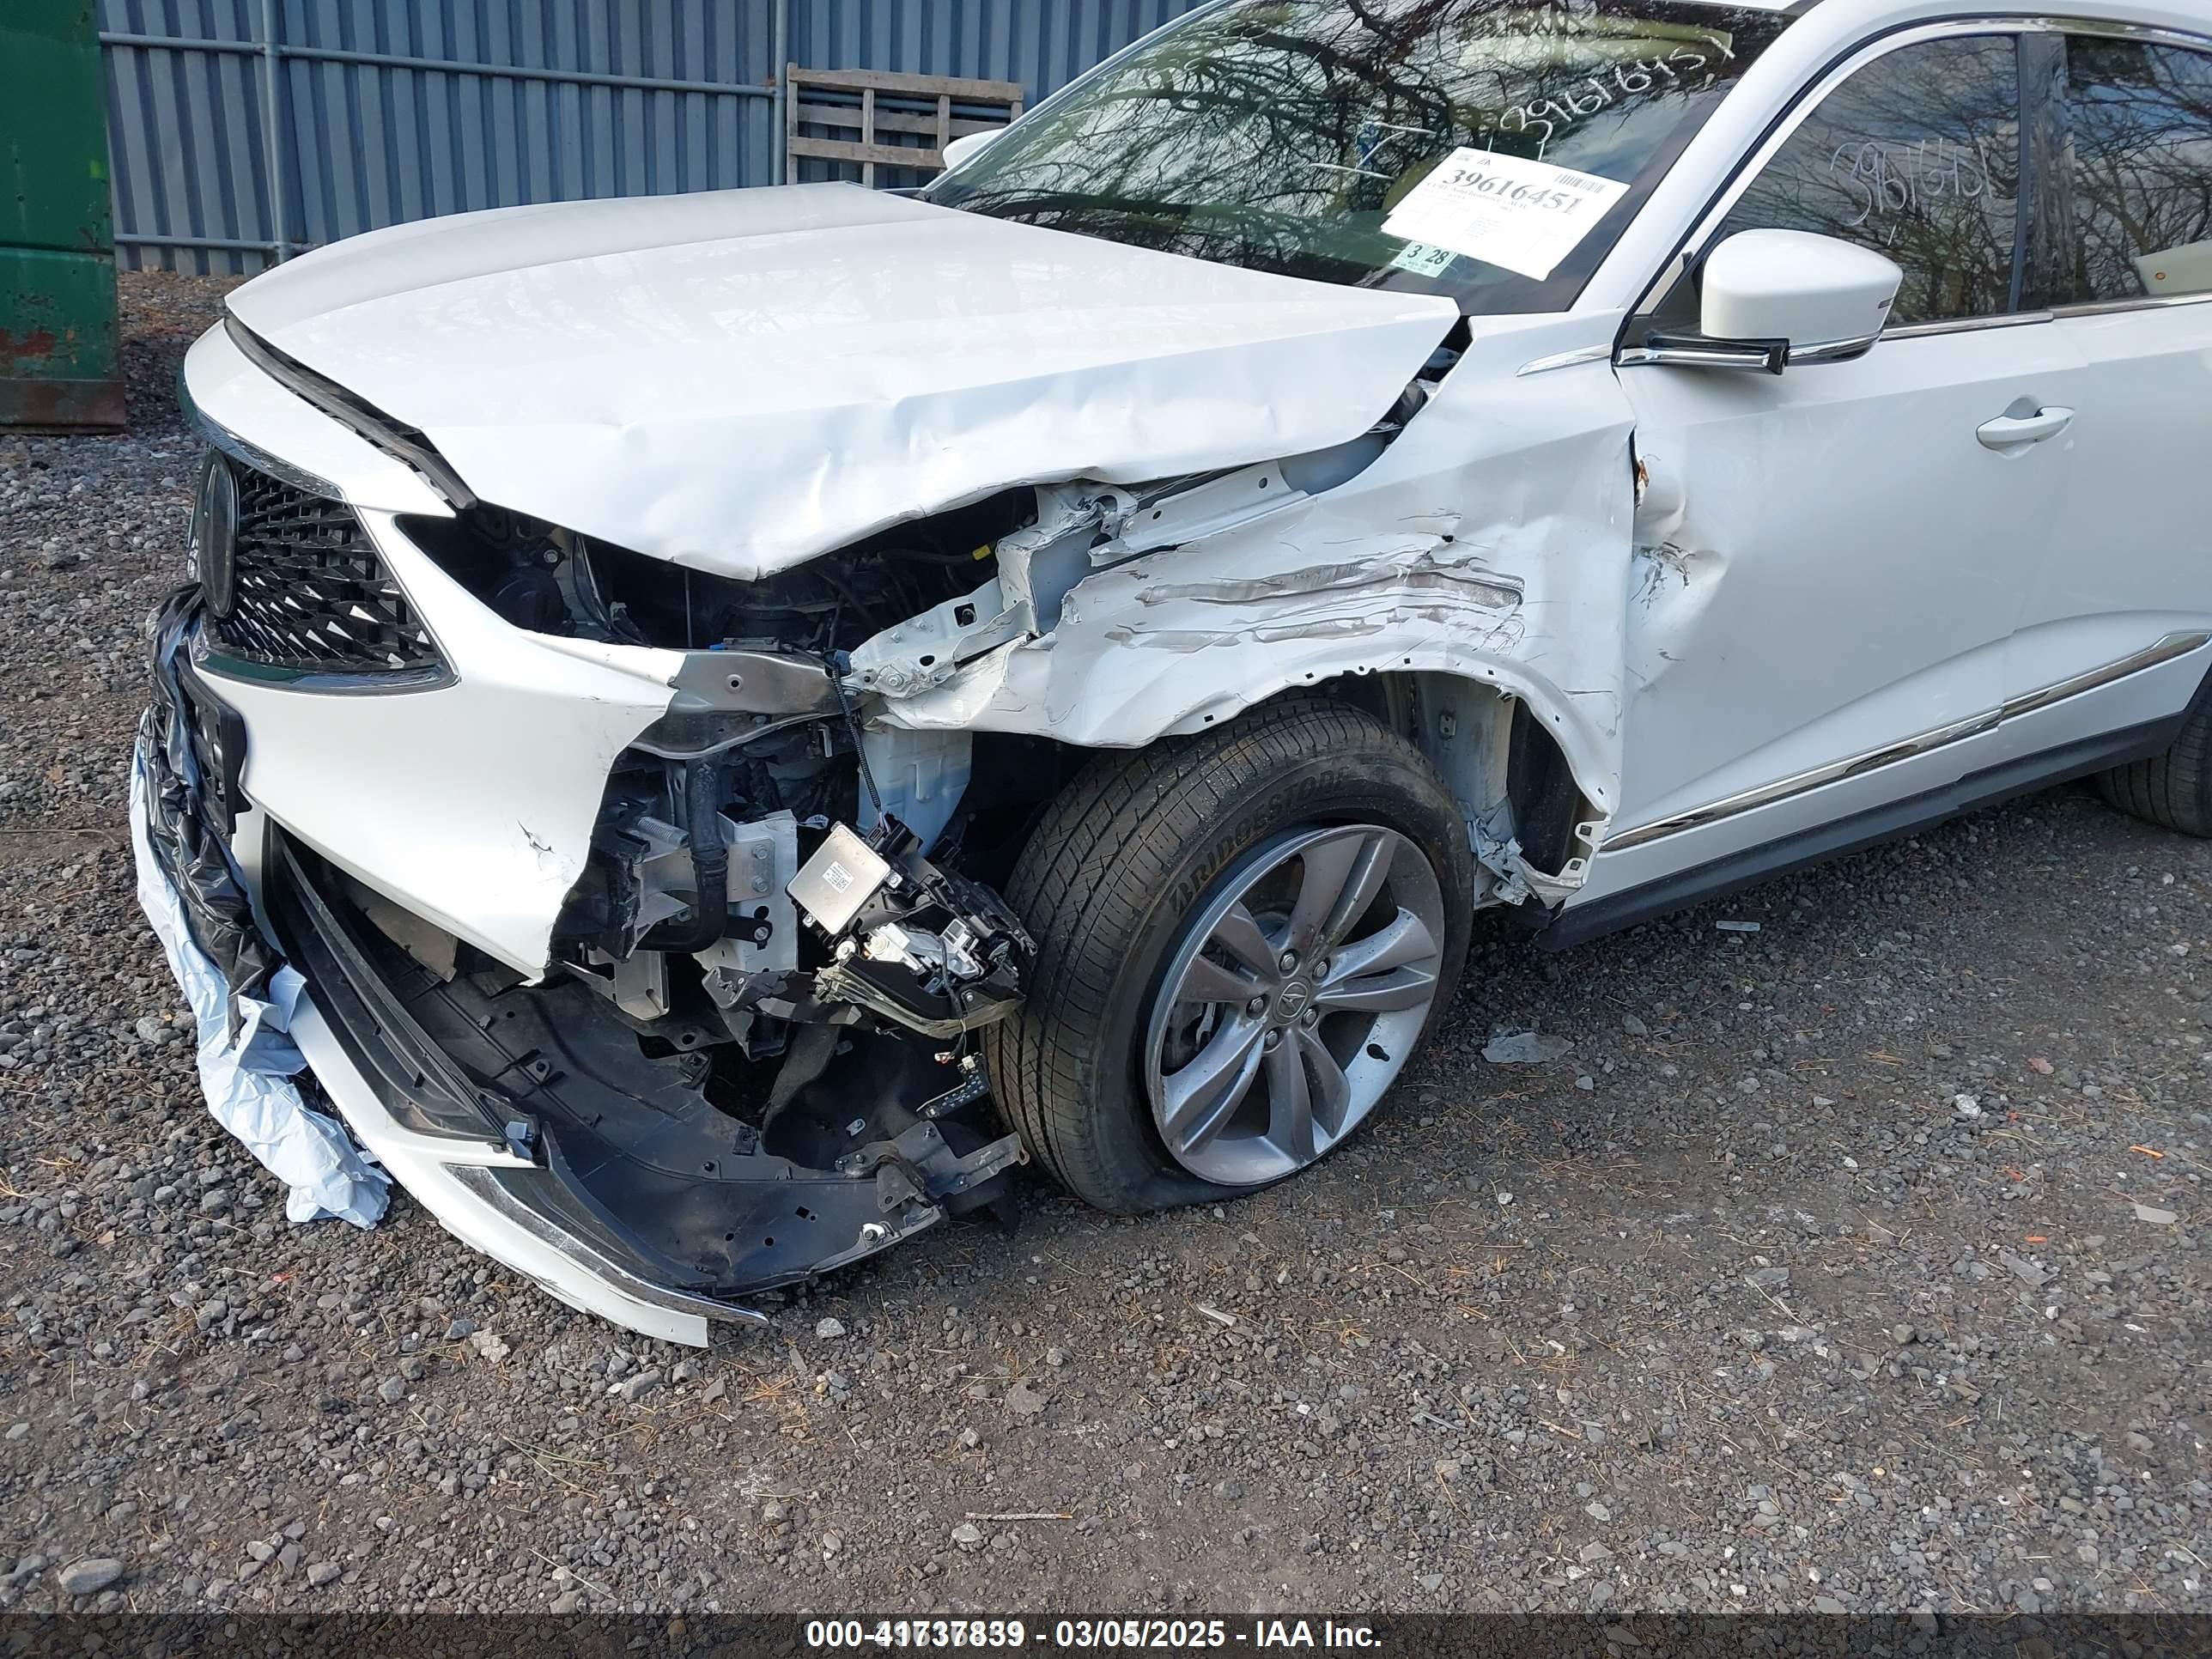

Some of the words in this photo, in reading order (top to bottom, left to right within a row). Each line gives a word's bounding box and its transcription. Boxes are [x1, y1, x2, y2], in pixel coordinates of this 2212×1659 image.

[1443, 169, 1583, 215] 39616451
[1407, 244, 1423, 258] 3
[1425, 249, 1450, 264] 28
